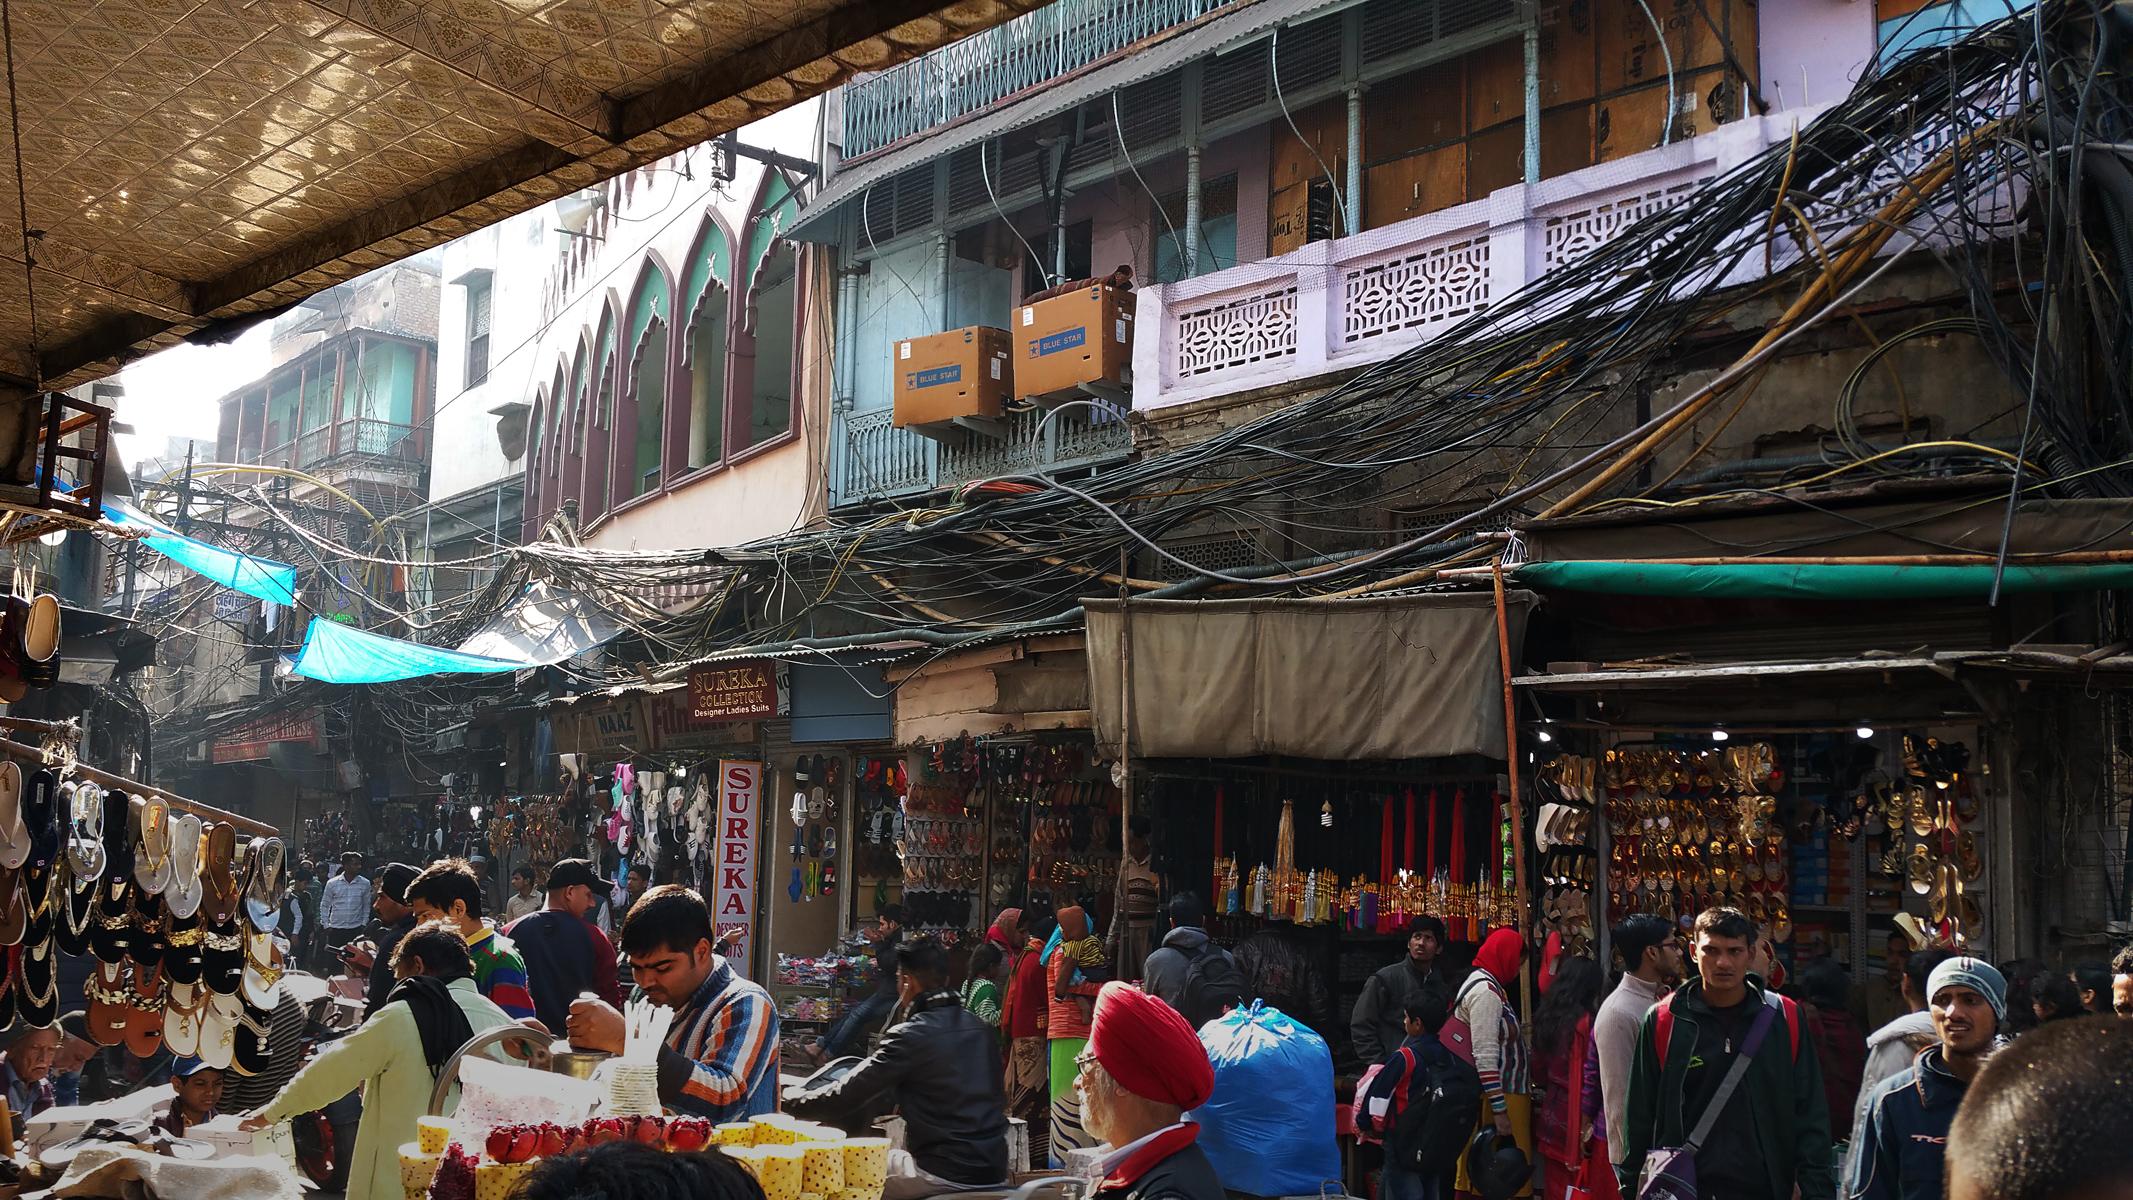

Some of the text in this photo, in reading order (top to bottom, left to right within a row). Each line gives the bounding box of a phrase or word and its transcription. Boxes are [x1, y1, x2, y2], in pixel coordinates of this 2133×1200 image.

[1043, 333, 1082, 350] BLUE STAR
[919, 374, 937, 384] BLUE
[939, 369, 958, 380] STAR
[694, 668, 768, 694] SUREKA
[699, 690, 763, 708] COLLECTION
[694, 703, 770, 718] Designer Ladies Suits
[598, 712, 634, 734] NAAZ
[721, 767, 752, 915] SUREKA
